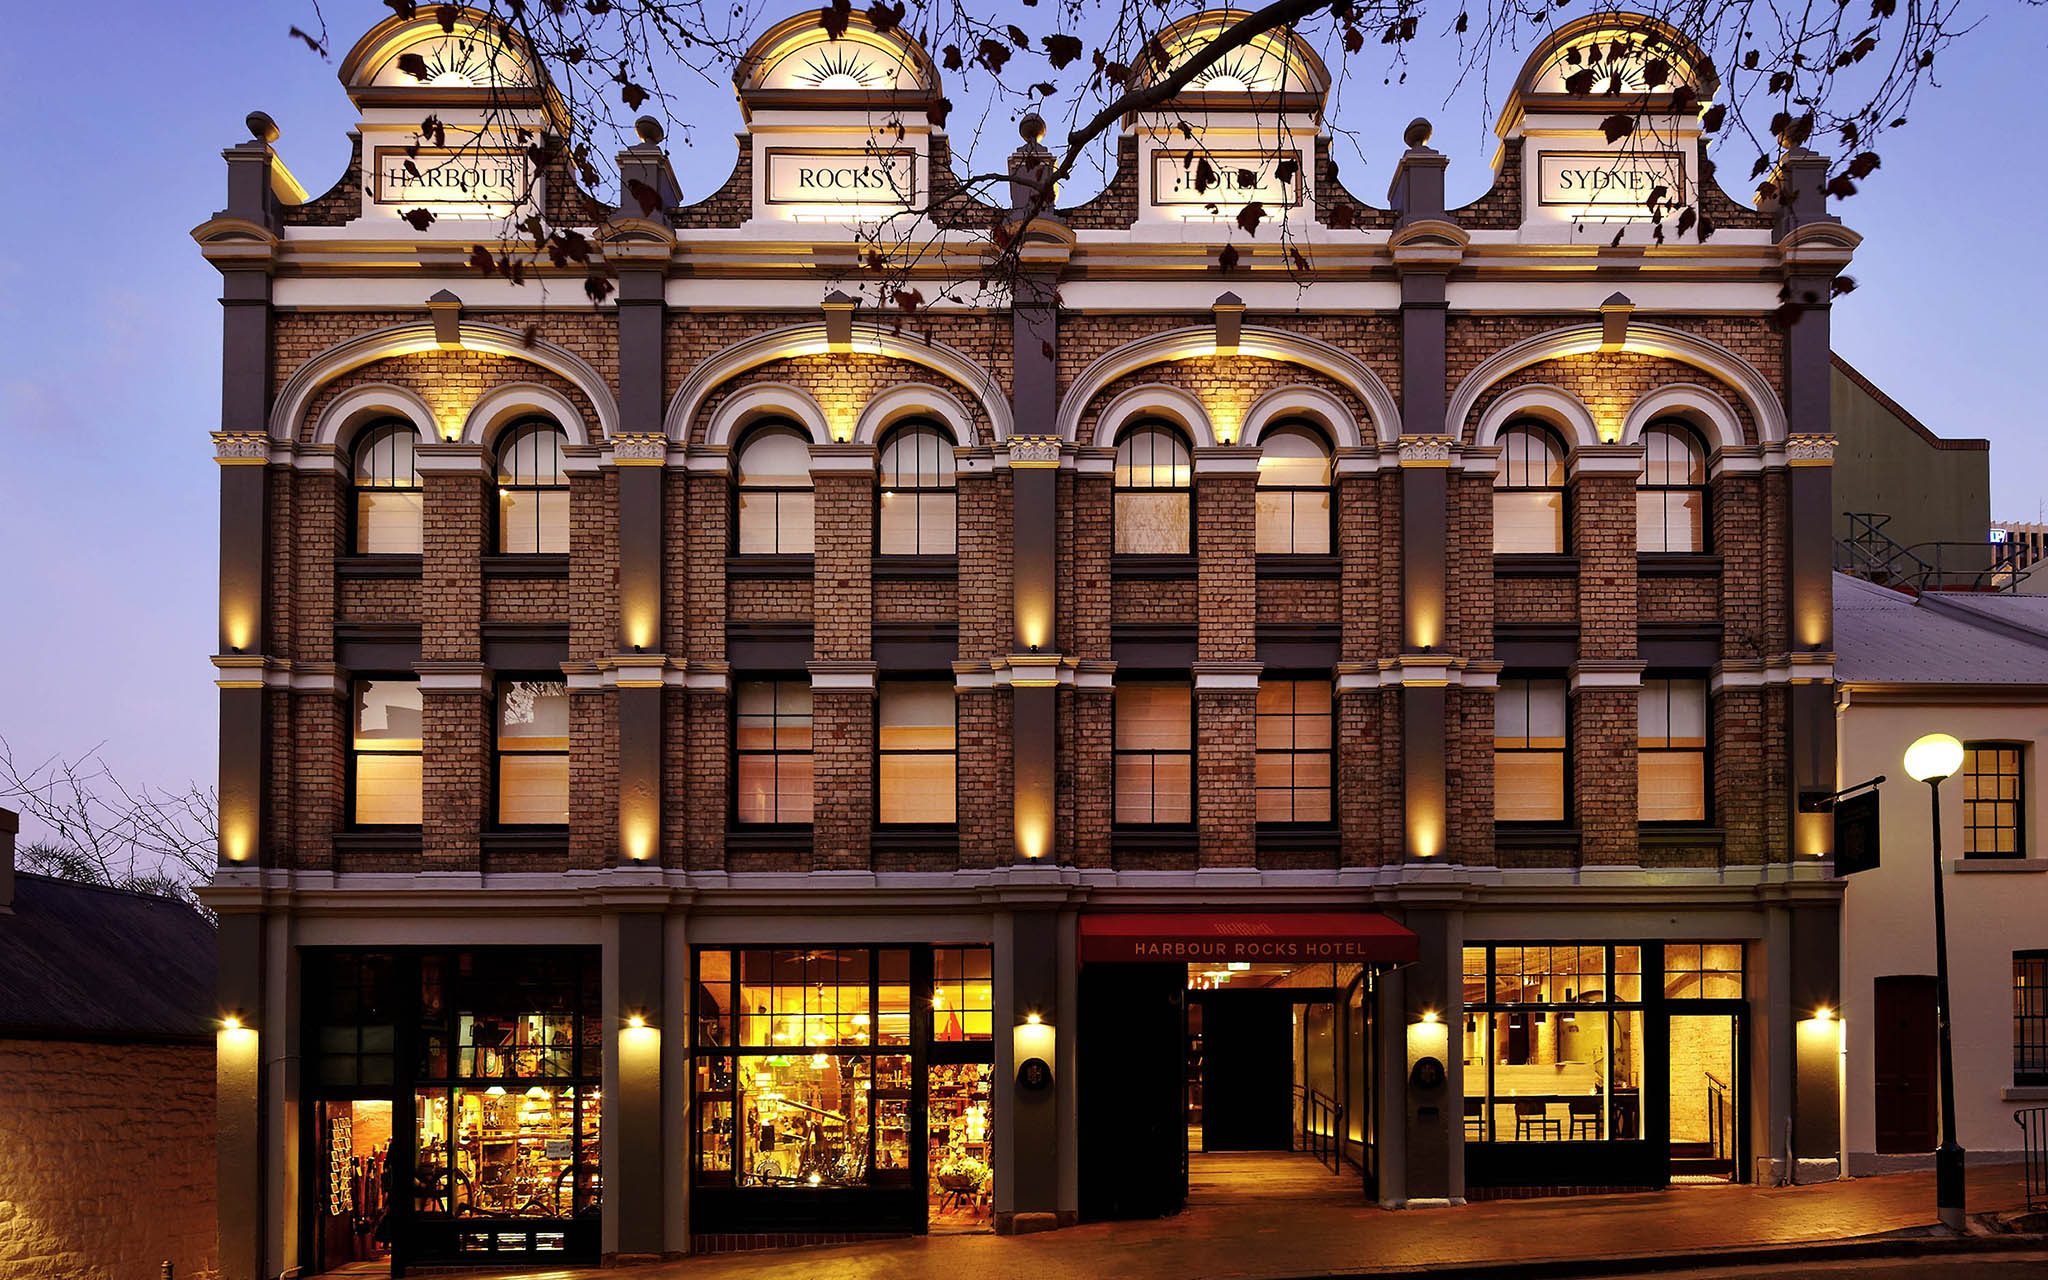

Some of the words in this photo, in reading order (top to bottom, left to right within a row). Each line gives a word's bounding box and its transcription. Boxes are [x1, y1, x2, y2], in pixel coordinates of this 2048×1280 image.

[389, 168, 516, 188] HARBOUR
[799, 168, 884, 189] ROCKS
[1184, 170, 1269, 190] HOTL
[1559, 169, 1661, 190] SYDNEY
[1135, 943, 1226, 955] HARBOUR
[1235, 943, 1297, 955] ROCKS
[1306, 943, 1366, 955] HOTEL
